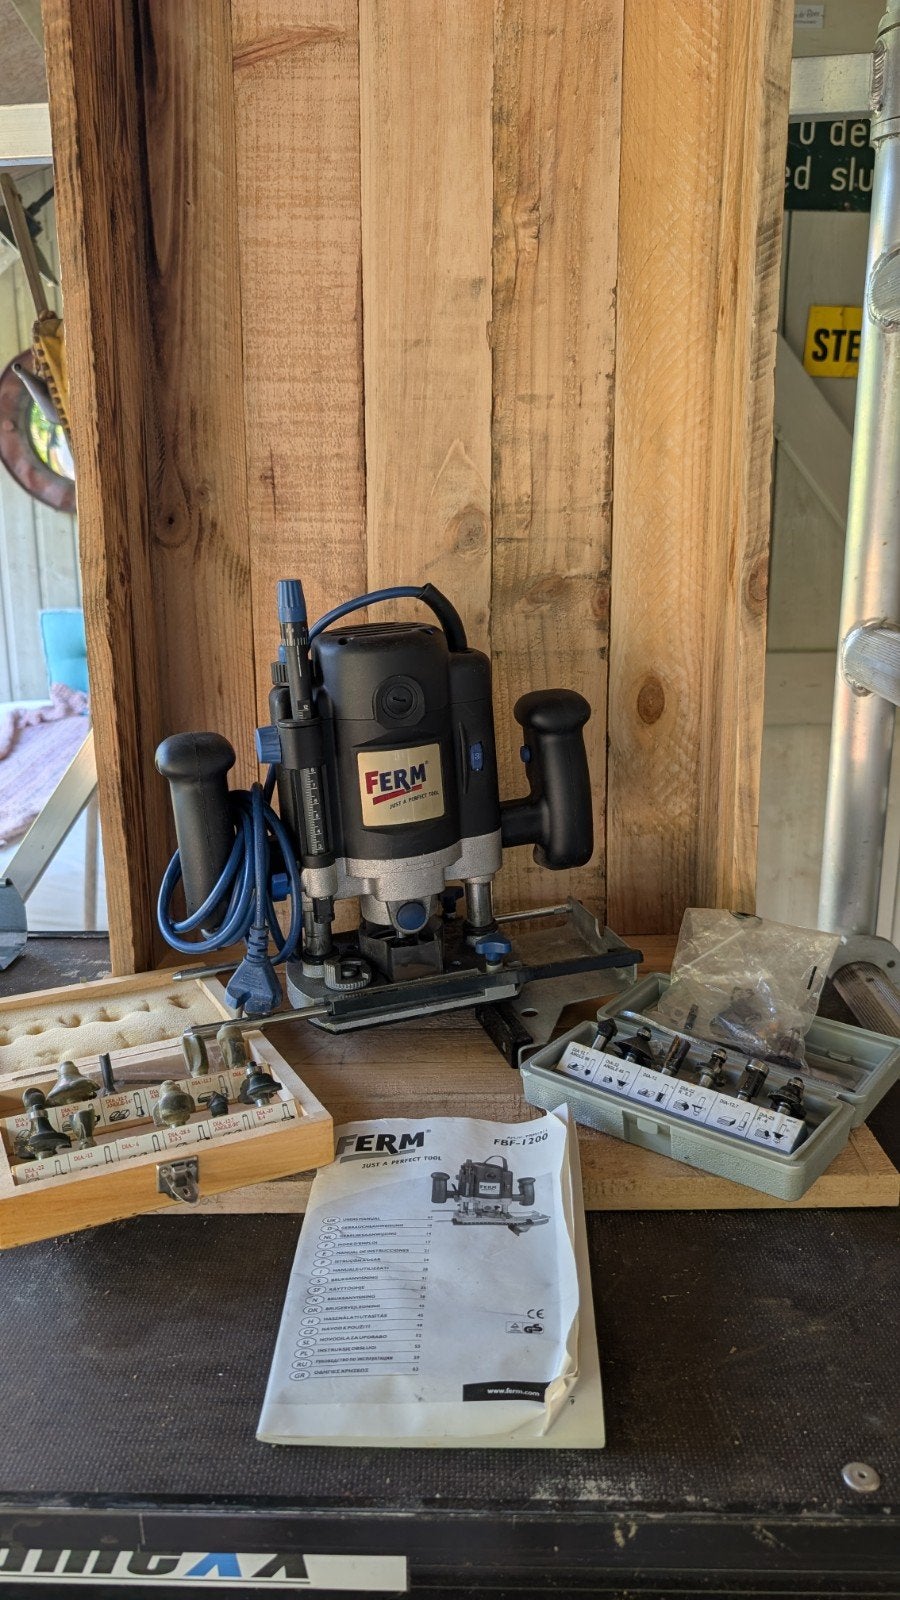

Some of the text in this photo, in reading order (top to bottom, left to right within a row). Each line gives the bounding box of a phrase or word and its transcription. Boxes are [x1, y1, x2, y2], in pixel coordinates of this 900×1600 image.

[830, 118, 870, 147] de
[830, 157, 873, 192] slu
[812, 328, 862, 363] STE
[364, 763, 427, 794] FERM
[389, 801, 402, 810] JUST
[408, 793, 428, 803] PERFECT
[428, 790, 440, 798] TOOL
[336, 1131, 425, 1155] FERM
[493, 1132, 549, 1146] FBF-1200
[391, 1157, 421, 1165] PERFECT
[523, 1323, 543, 1334] GS
[487, 1387, 540, 1397] www.ferm.com
